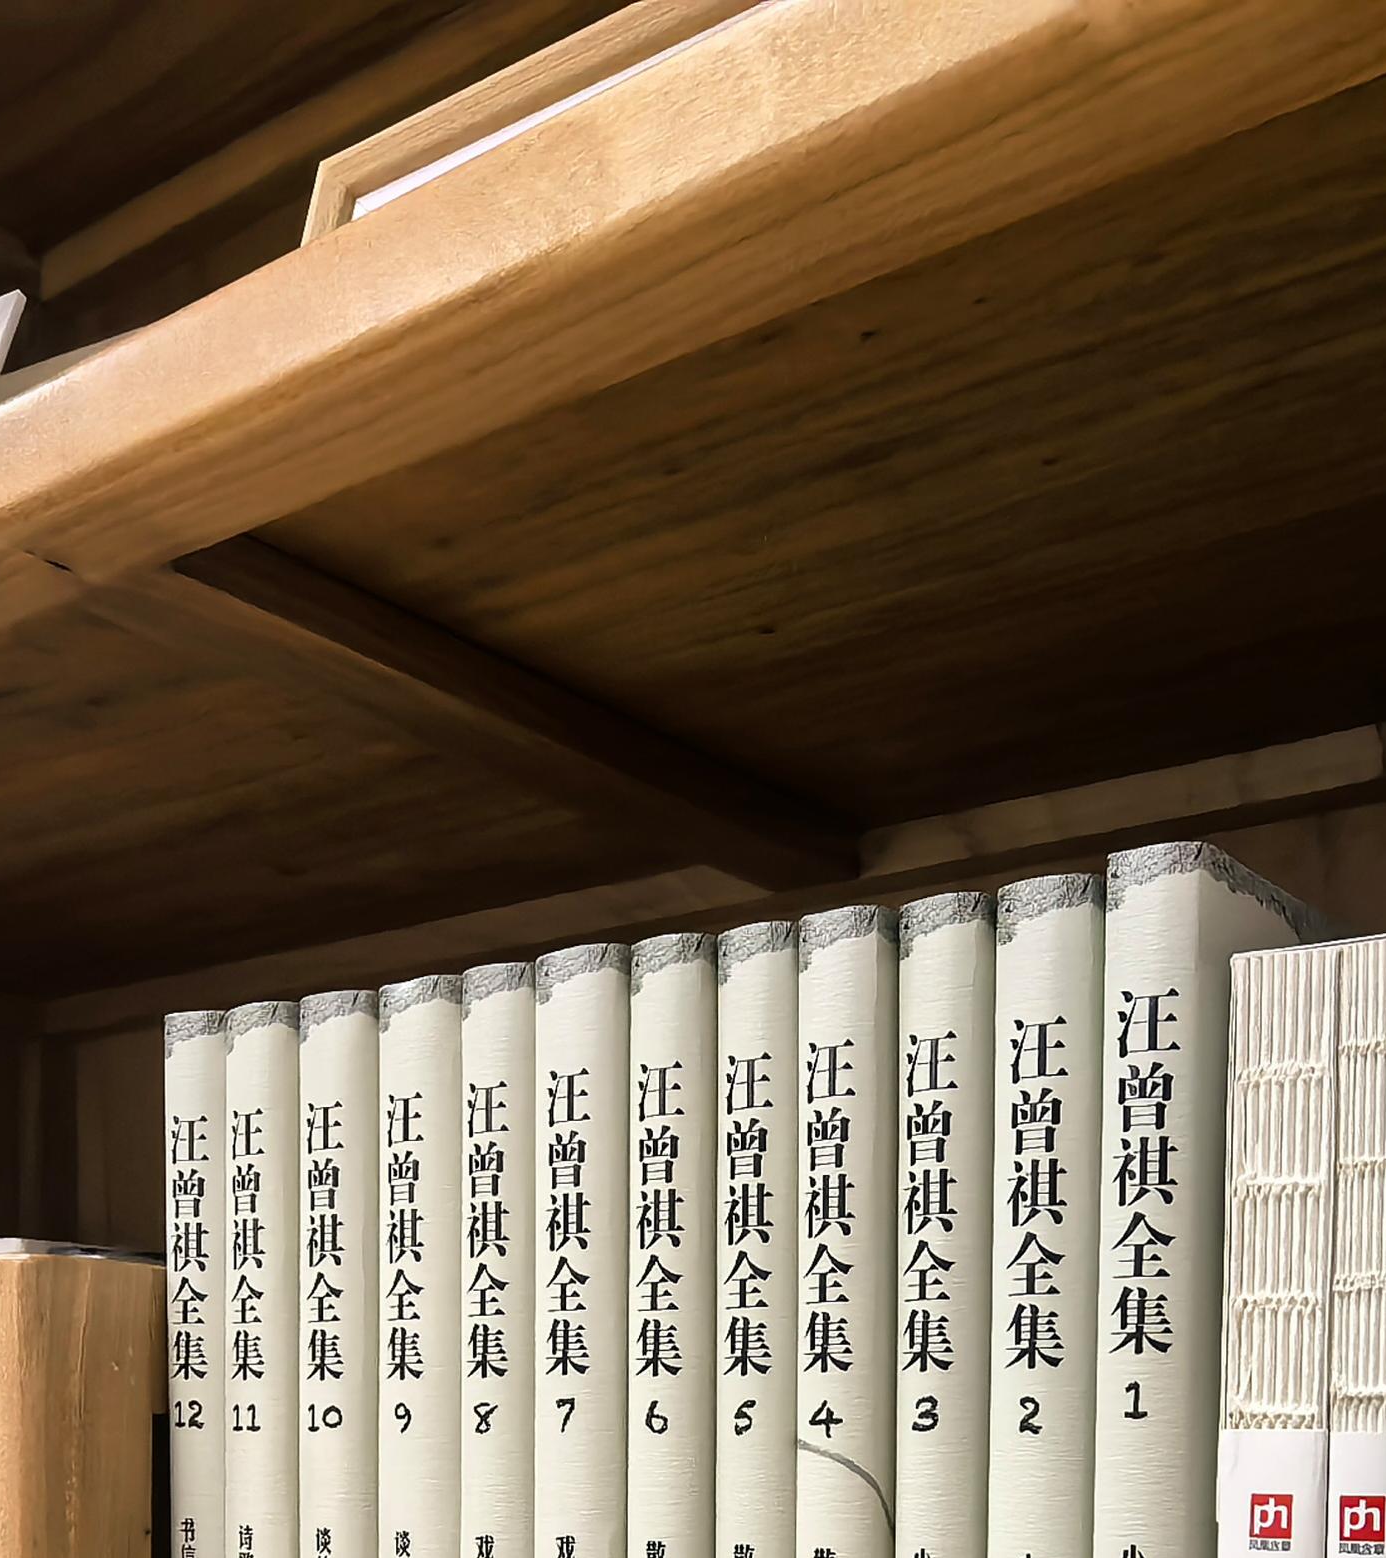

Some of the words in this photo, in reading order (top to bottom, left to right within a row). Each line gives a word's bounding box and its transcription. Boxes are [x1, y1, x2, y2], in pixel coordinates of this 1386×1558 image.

[168, 1115, 210, 1381] 汪曾祺全集
[231, 1107, 266, 1381] 汪曾祺全集
[306, 1100, 346, 1382] 汪曾祺全集
[385, 1091, 425, 1381] 汪曾祺全集
[466, 1080, 511, 1379] 汪曾祺全集
[545, 1067, 592, 1376] 汪曾祺全集
[635, 1060, 686, 1378] 汪曾祺全集
[723, 1051, 775, 1377] 汪曾祺全集
[803, 1038, 857, 1374] 汪曾祺全集
[901, 1030, 959, 1373] 汪曾祺全集
[1005, 1015, 1069, 1370] 汪曾祺全集
[1108, 987, 1182, 1356] 汪曾祺全集
[174, 1399, 205, 1430] 12
[232, 1403, 262, 1433] 11
[307, 1403, 343, 1433] 10
[394, 1402, 412, 1434] 9
[473, 1401, 499, 1435] 8
[555, 1397, 576, 1434] 7
[644, 1399, 669, 1435] 6
[733, 1399, 757, 1437] 5
[808, 1399, 844, 1439] 4
[911, 1395, 940, 1433] 3
[1018, 1395, 1043, 1435] 2
[1124, 1380, 1149, 1420] 1
